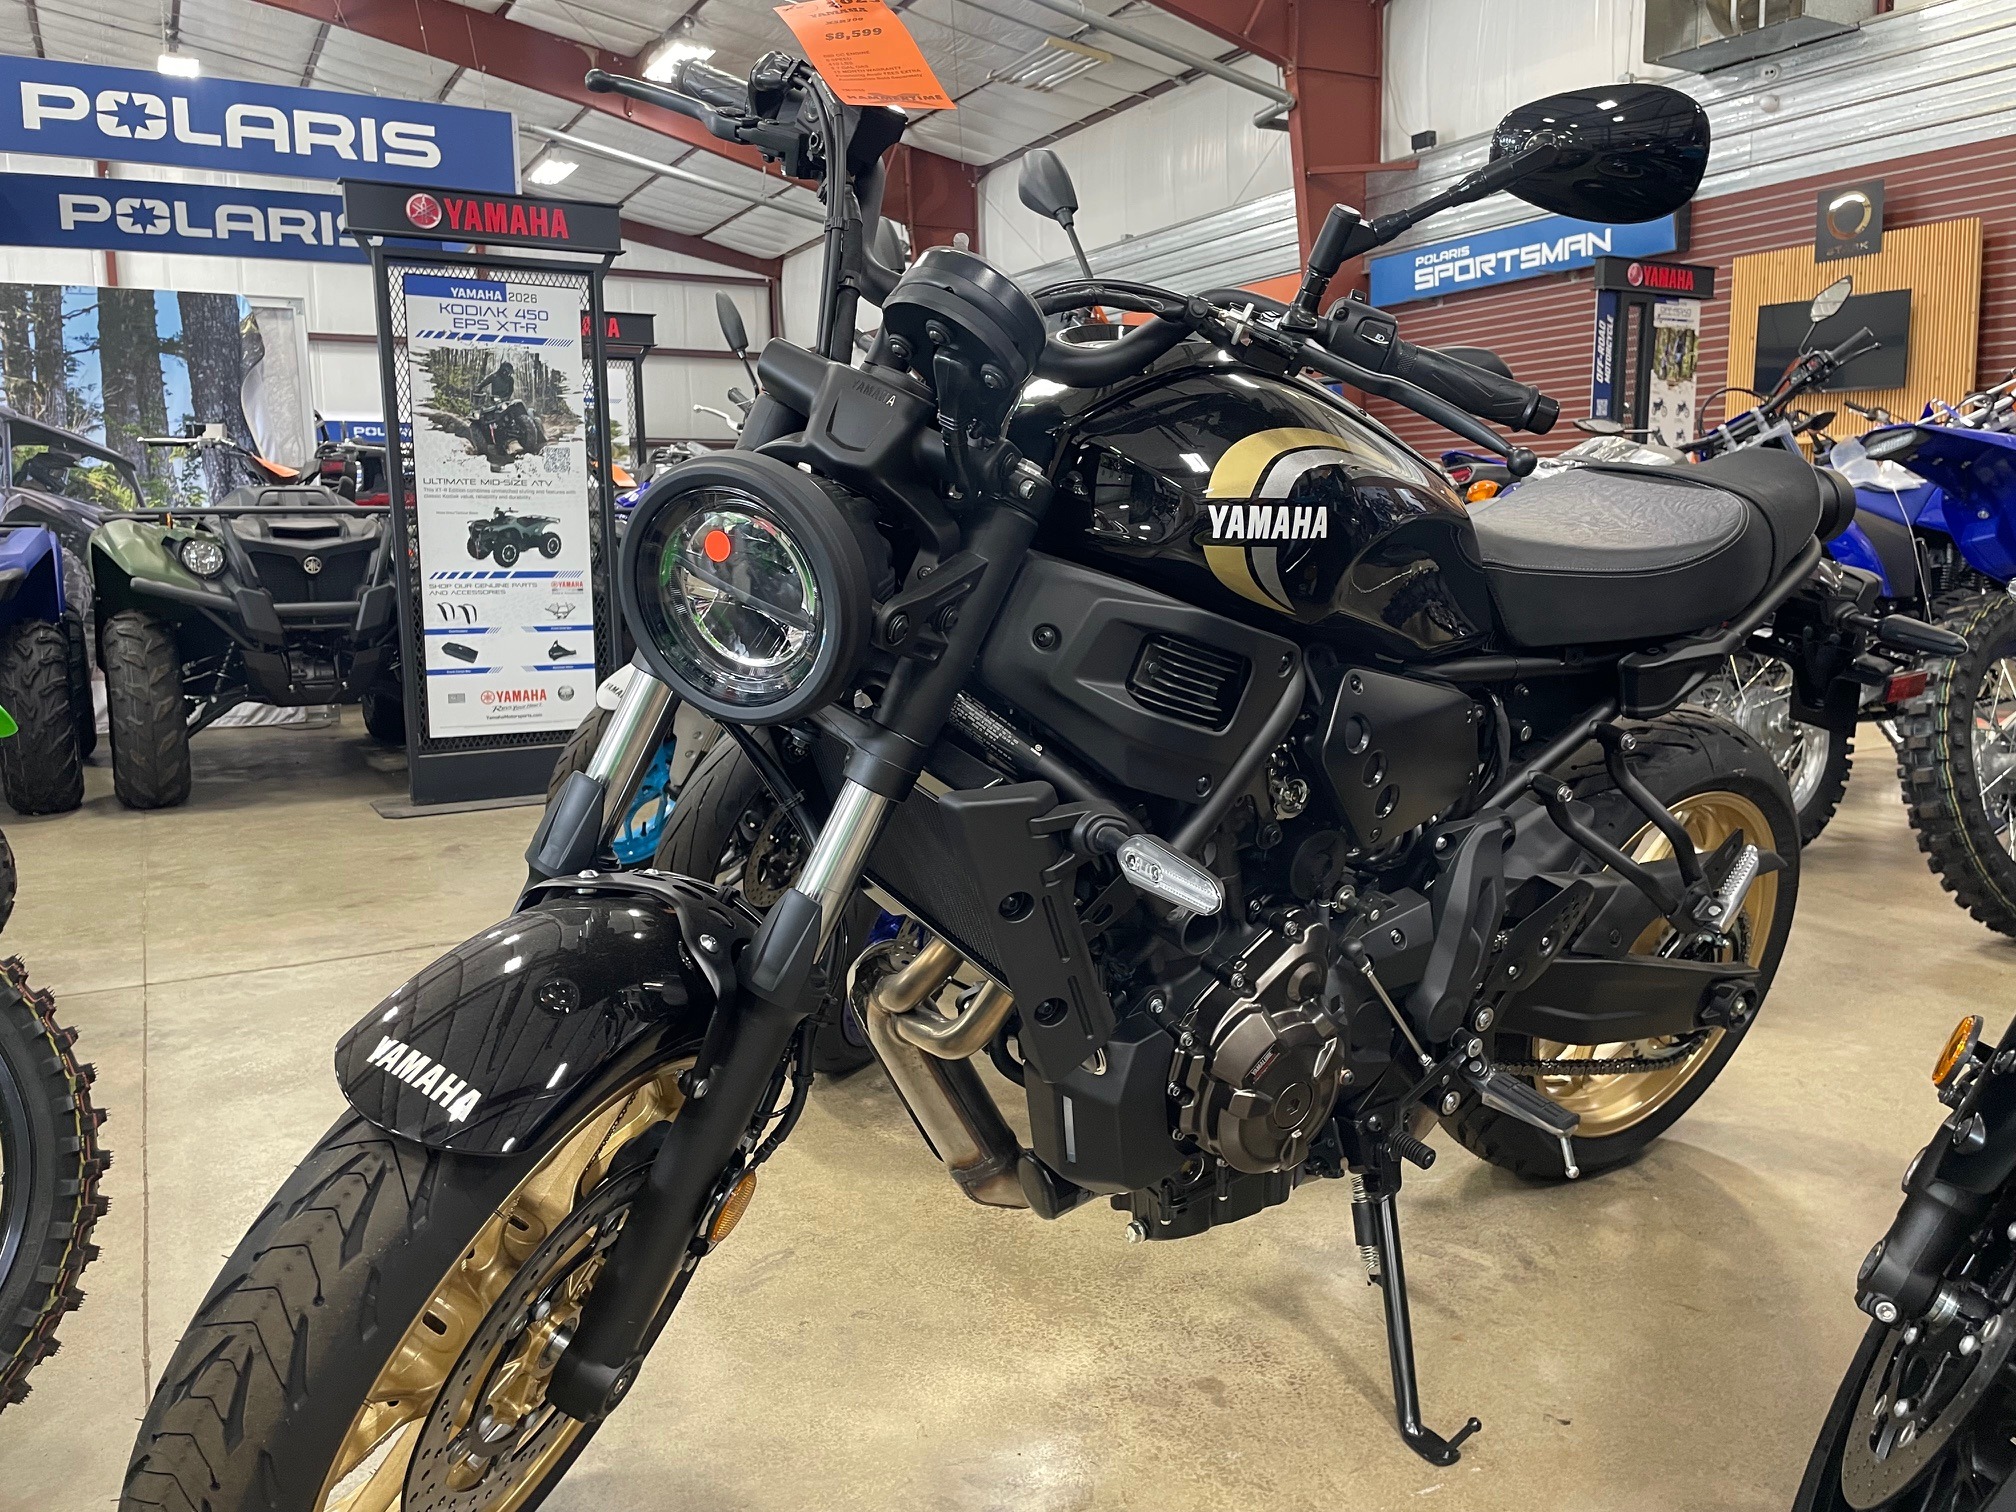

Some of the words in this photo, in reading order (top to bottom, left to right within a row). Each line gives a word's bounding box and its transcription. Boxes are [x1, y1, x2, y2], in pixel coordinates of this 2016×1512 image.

[810, 7, 868, 18] YAMAHA
[825, 27, 882, 41] $8,599
[20, 81, 442, 169] POLARIS
[443, 198, 569, 240] YAMAHA
[1415, 246, 1470, 268] POLARIS
[1415, 228, 1612, 291] SPORTSMAN
[1643, 265, 1694, 291] YAMAHA
[450, 287, 502, 301] YAMAHA
[508, 292, 538, 304] 2026
[439, 303, 508, 318] KODIAK
[515, 309, 549, 321] 450
[453, 318, 489, 330] EPS
[497, 321, 537, 333] XT-R
[1596, 320, 1607, 384] OFF-ROAD
[1604, 314, 1616, 385] MOTORCYCLE
[423, 478, 477, 486] ULTIMATE
[480, 479, 528, 487] MID-SIZE
[1208, 505, 1328, 540] YAMAHA
[496, 689, 547, 703] YAMAHA
[605, 683, 625, 699] YAMA
[366, 1035, 482, 1123] YAMAHA
